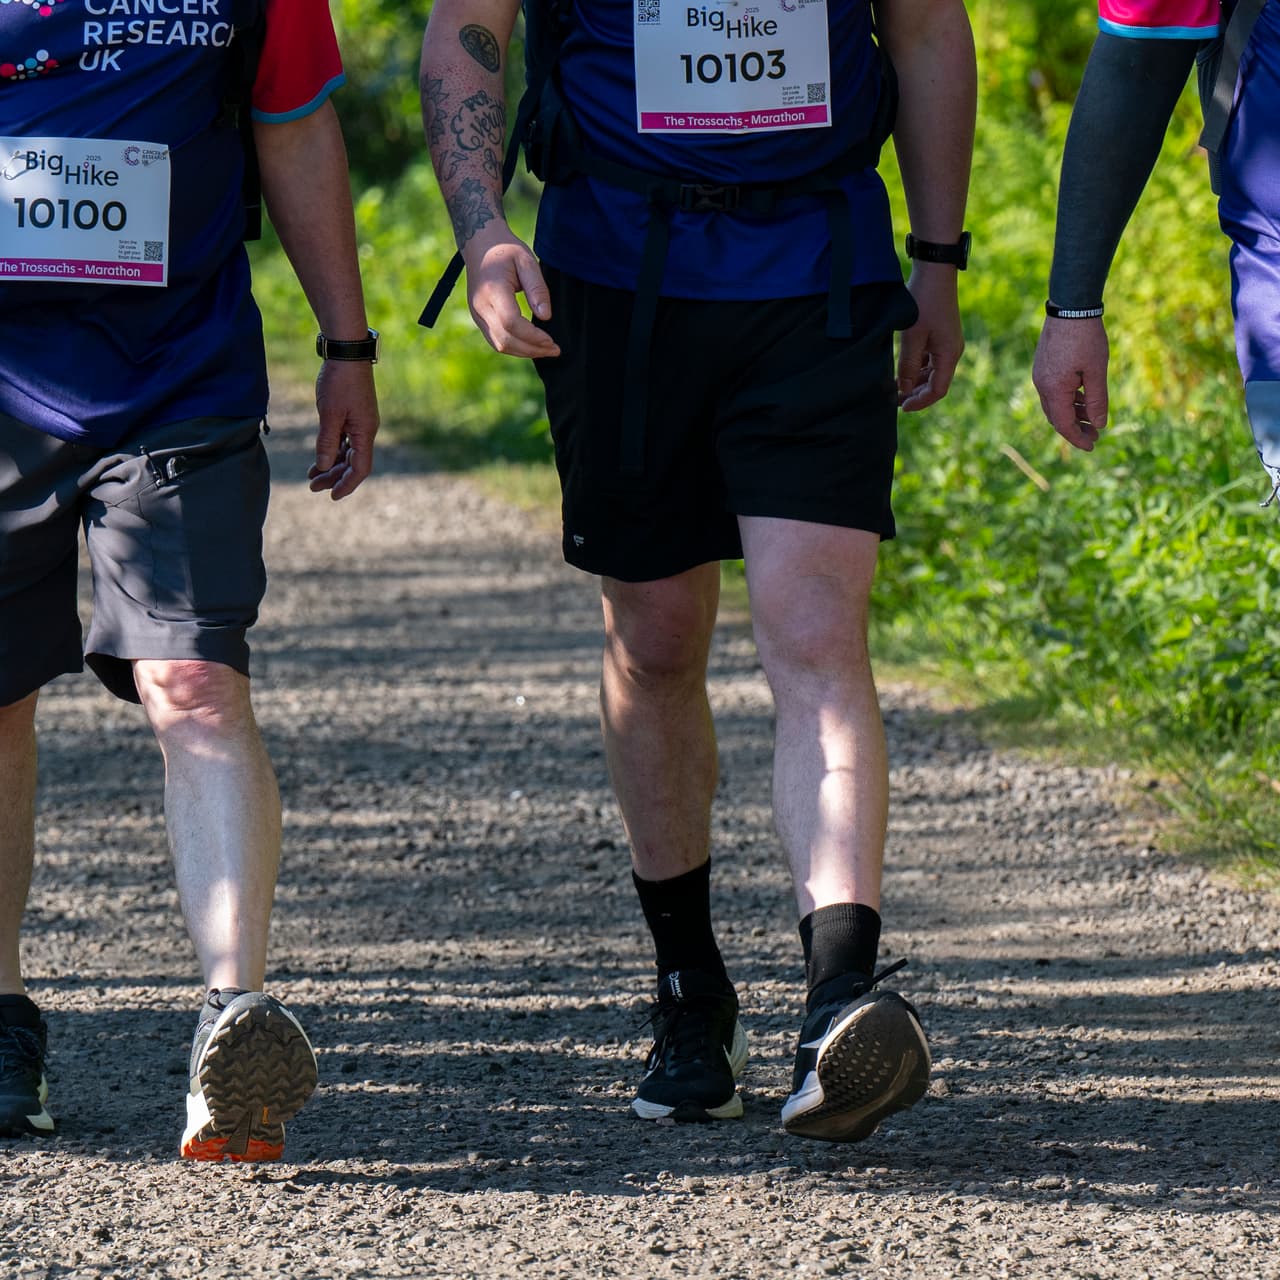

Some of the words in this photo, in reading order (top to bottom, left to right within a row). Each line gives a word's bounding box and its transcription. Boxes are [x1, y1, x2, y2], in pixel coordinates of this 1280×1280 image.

[687, 6, 725, 32] Big
[726, 15, 778, 40] Hike
[78, 49, 125, 72] UK
[680, 49, 786, 84] 10103
[664, 116, 685, 126] The
[687, 115, 742, 127] Trossachs
[751, 112, 805, 125] Marathon
[26, 150, 63, 175] Big
[65, 162, 119, 186] Hike
[13, 197, 128, 231] 10100
[19, 263, 76, 274] Trossachs
[85, 265, 141, 277] Marathon
